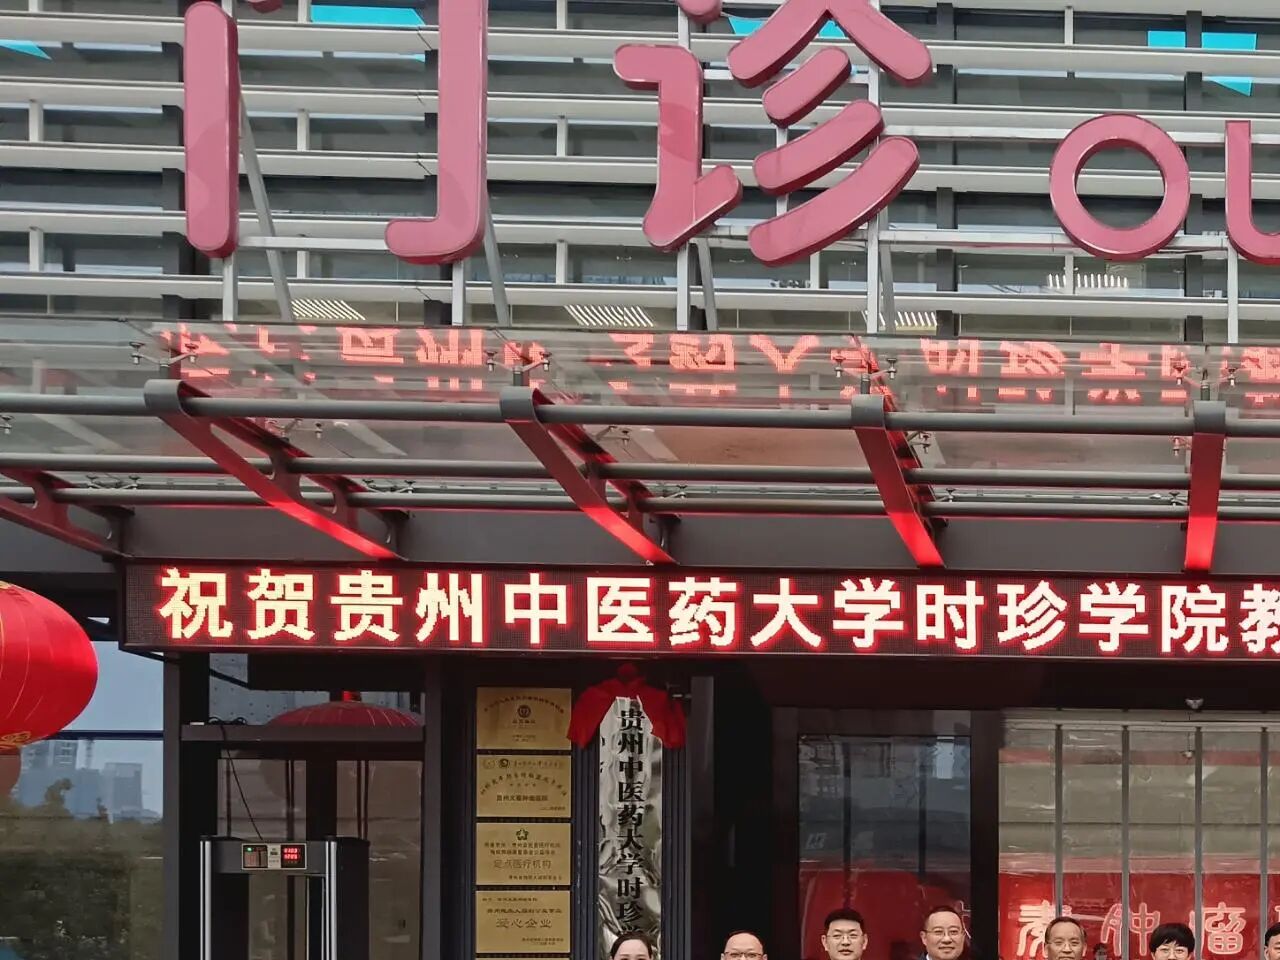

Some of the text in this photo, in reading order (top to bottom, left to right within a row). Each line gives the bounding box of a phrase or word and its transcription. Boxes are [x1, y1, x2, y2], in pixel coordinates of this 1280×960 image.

[184, 0, 933, 266] 门诊
[617, 708, 646, 931] 贵州中医药大学时珍
